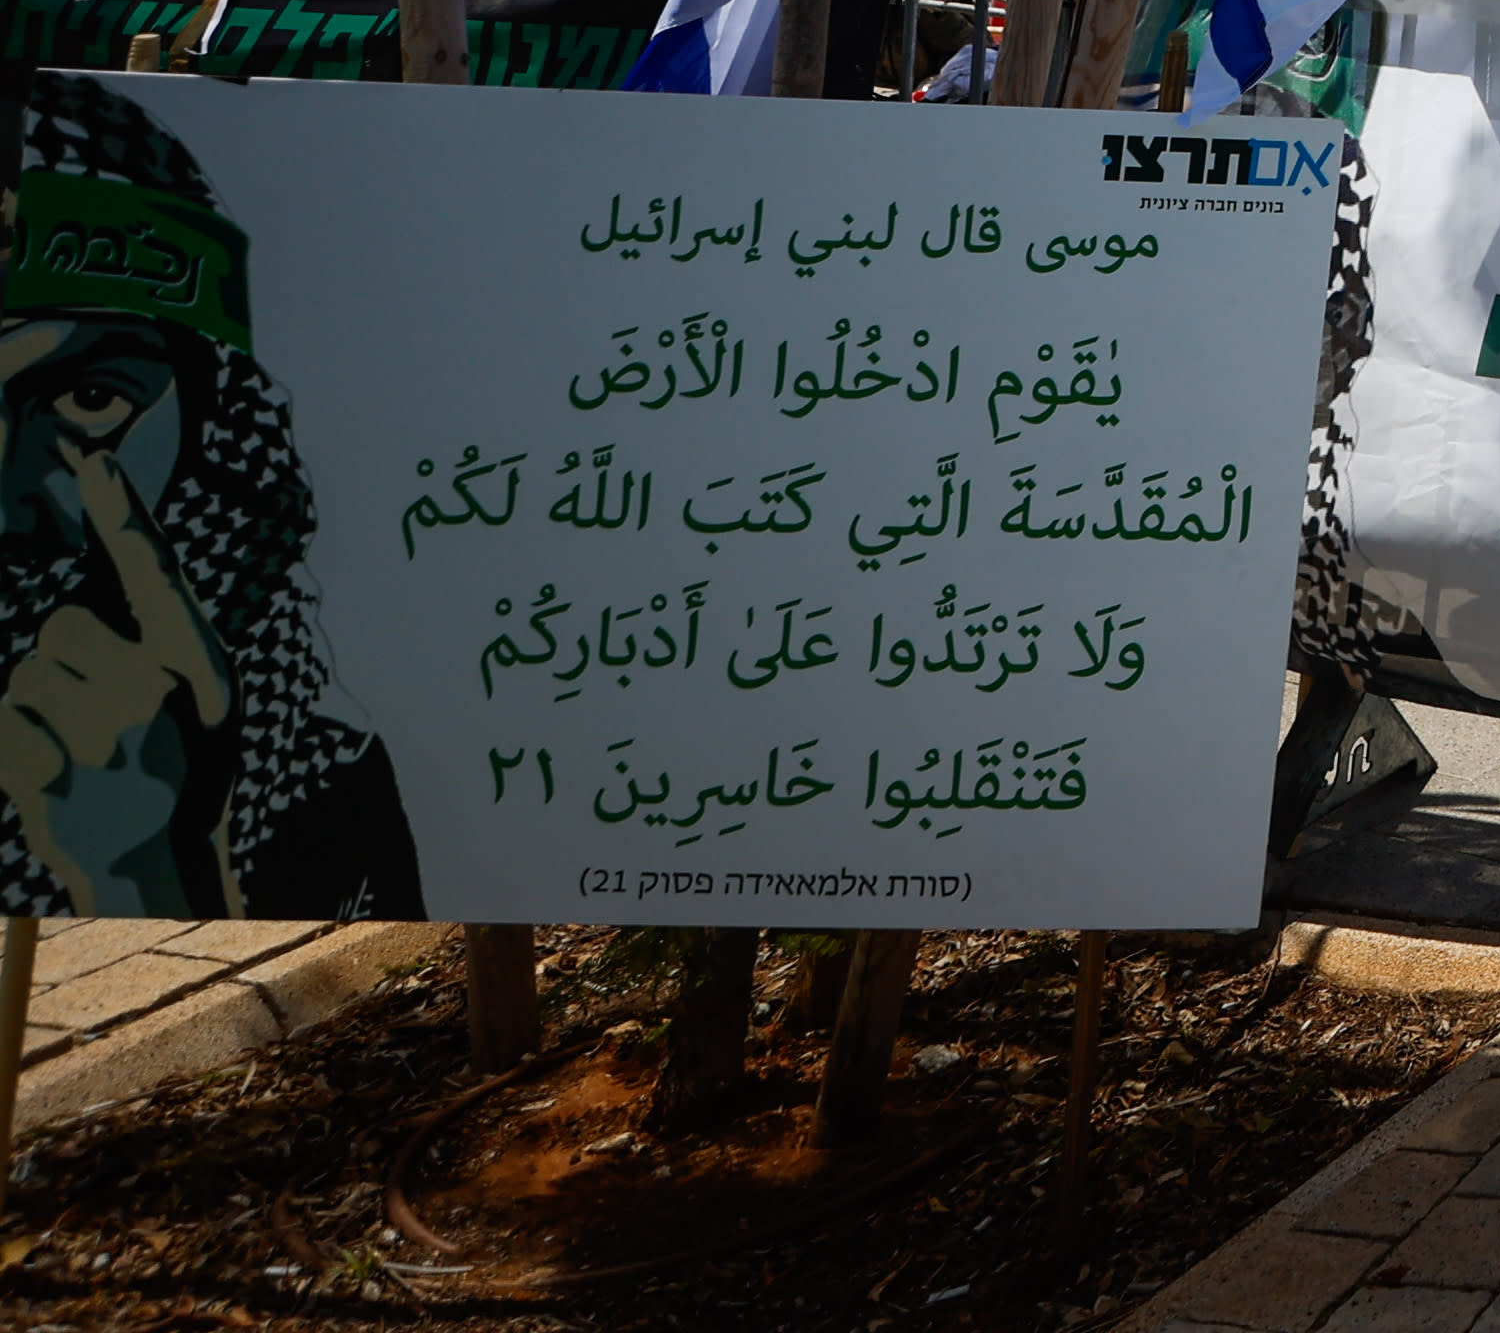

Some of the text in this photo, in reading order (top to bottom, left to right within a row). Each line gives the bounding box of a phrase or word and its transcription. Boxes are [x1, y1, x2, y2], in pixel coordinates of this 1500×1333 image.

[1139, 196, 1284, 214] בונים חברה ציונית
[581, 195, 1160, 277] موسى قال لبني إسرائيل
[638, 868, 714, 902] פסוק
[722, 867, 878, 900] אלמאאידה
